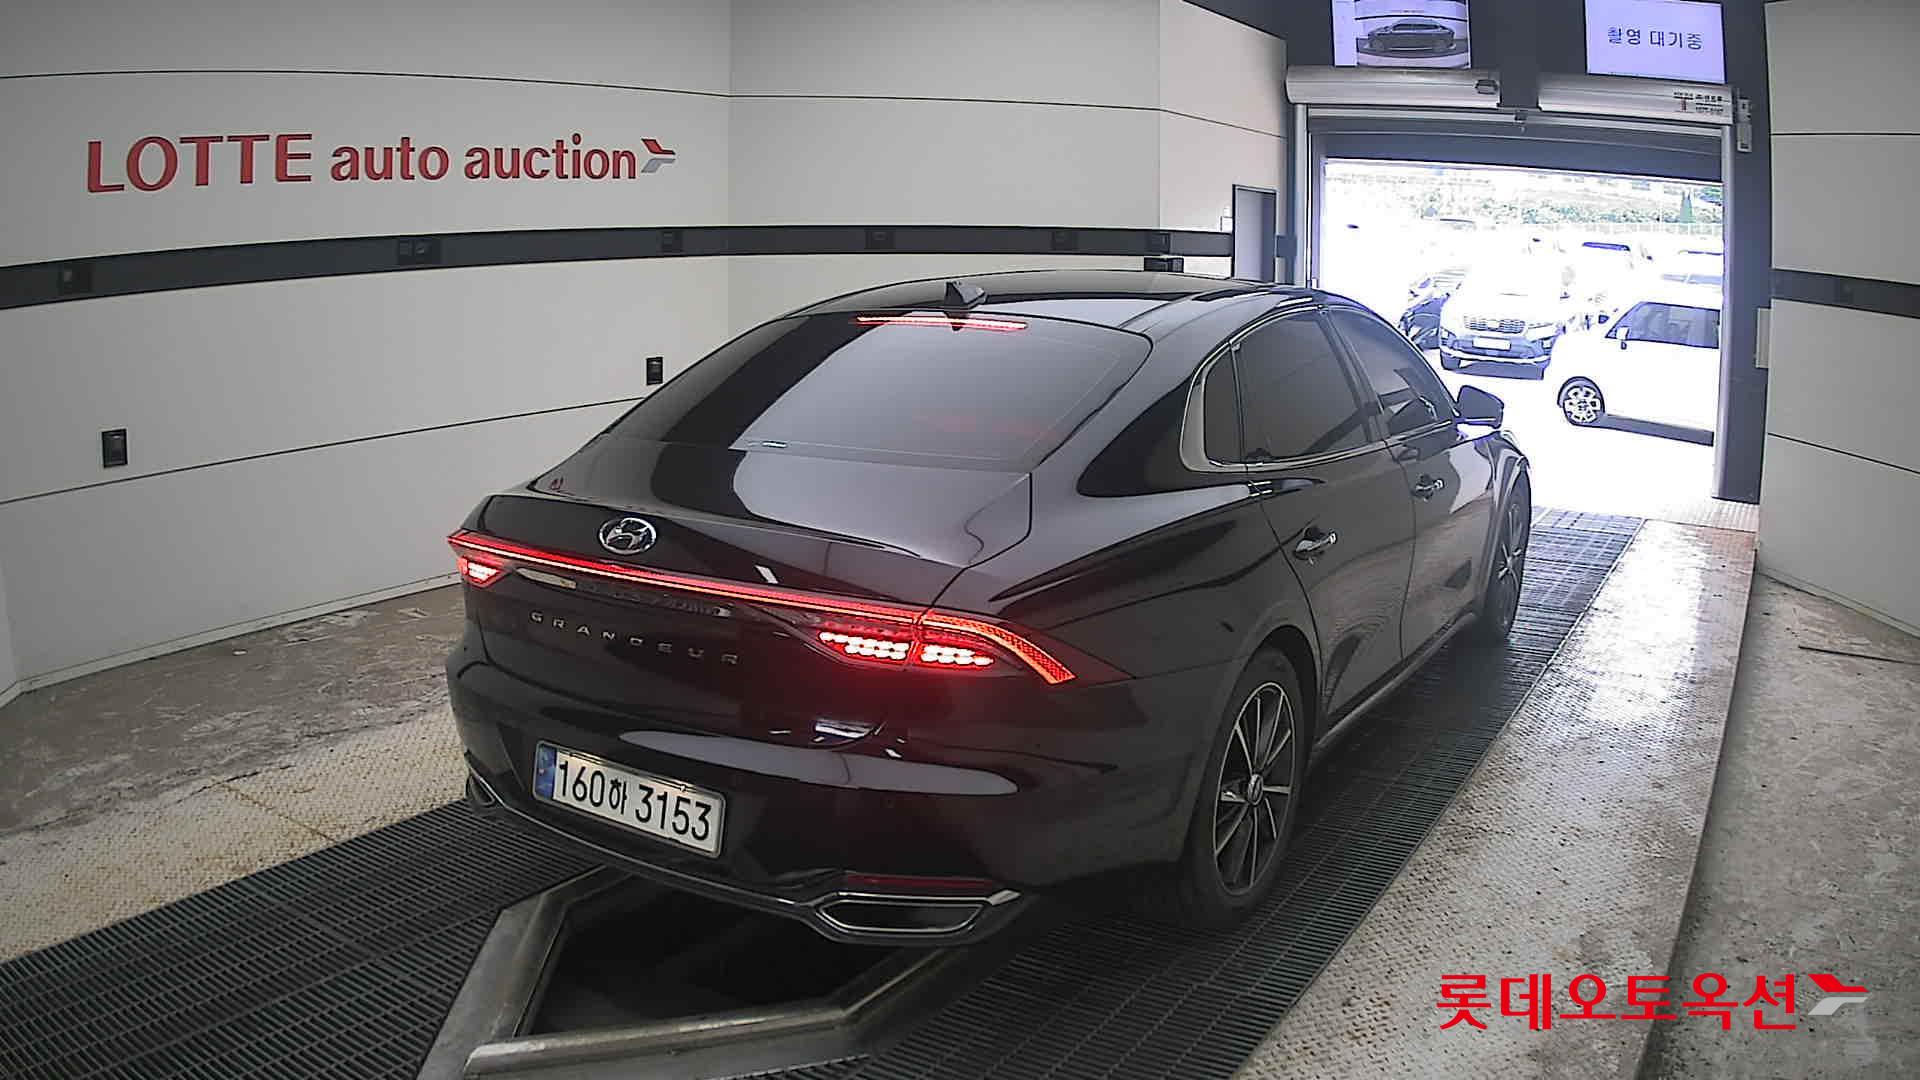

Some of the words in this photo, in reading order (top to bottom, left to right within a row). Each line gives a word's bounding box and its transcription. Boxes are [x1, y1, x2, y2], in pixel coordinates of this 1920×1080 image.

[1650, 30, 1703, 50] 대기중
[87, 133, 313, 193] LOTTE
[330, 136, 450, 181] auto
[464, 132, 637, 180] auction
[529, 611, 739, 665] GRANDEUR
[558, 760, 628, 815] 160하
[635, 784, 712, 841] 3153
